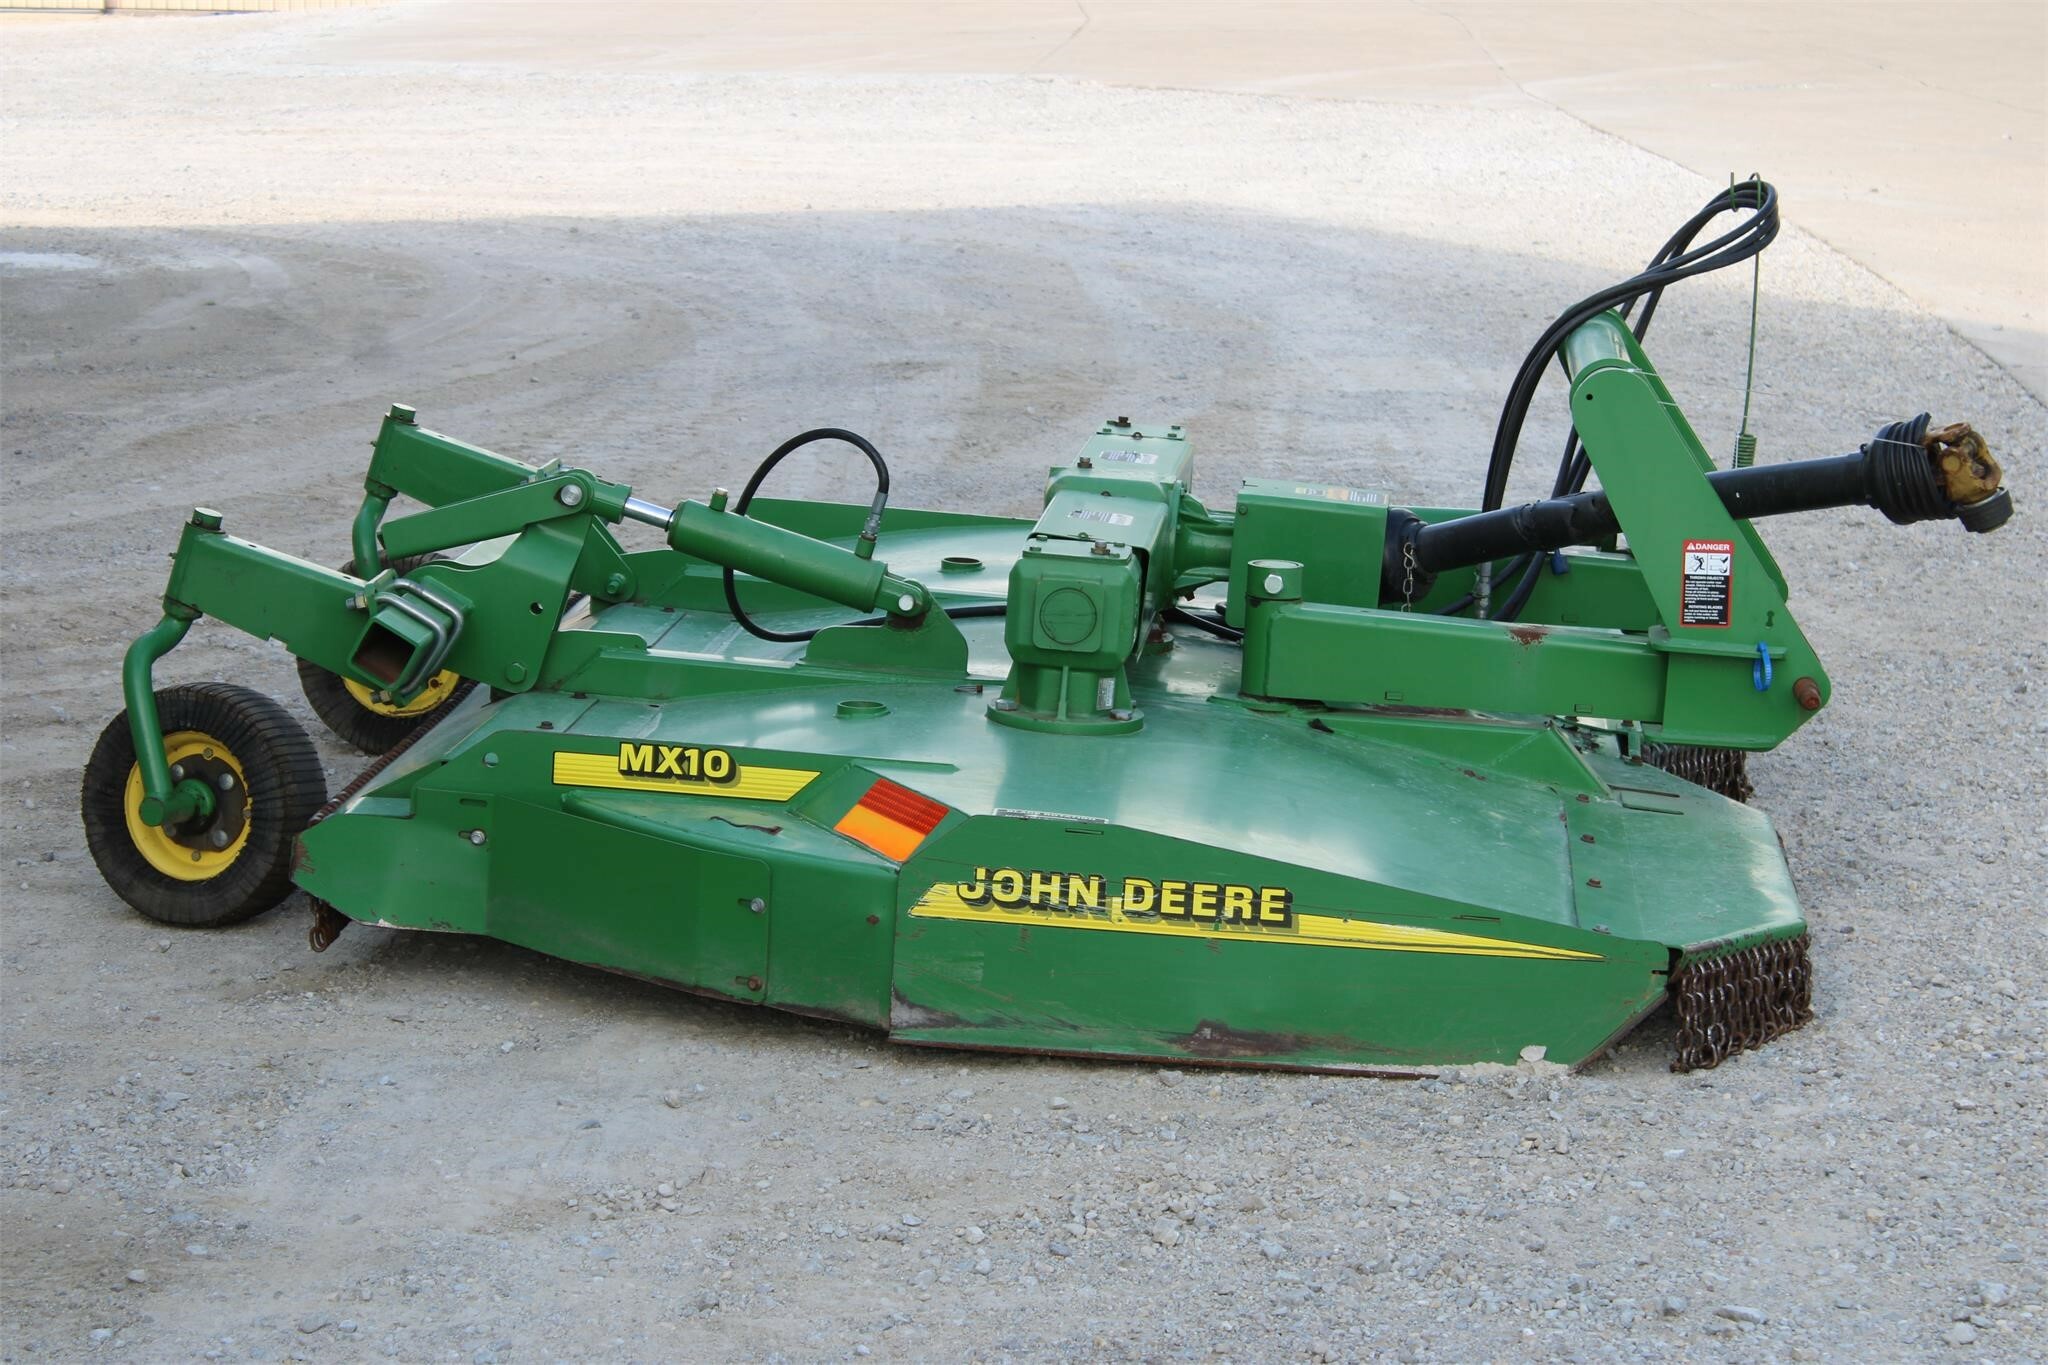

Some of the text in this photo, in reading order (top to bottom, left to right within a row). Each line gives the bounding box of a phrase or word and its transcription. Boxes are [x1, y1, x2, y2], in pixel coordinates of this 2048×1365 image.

[1696, 543, 1730, 551] DANGER
[618, 742, 733, 782] MX10
[957, 867, 1290, 925] JOHN DEERE
